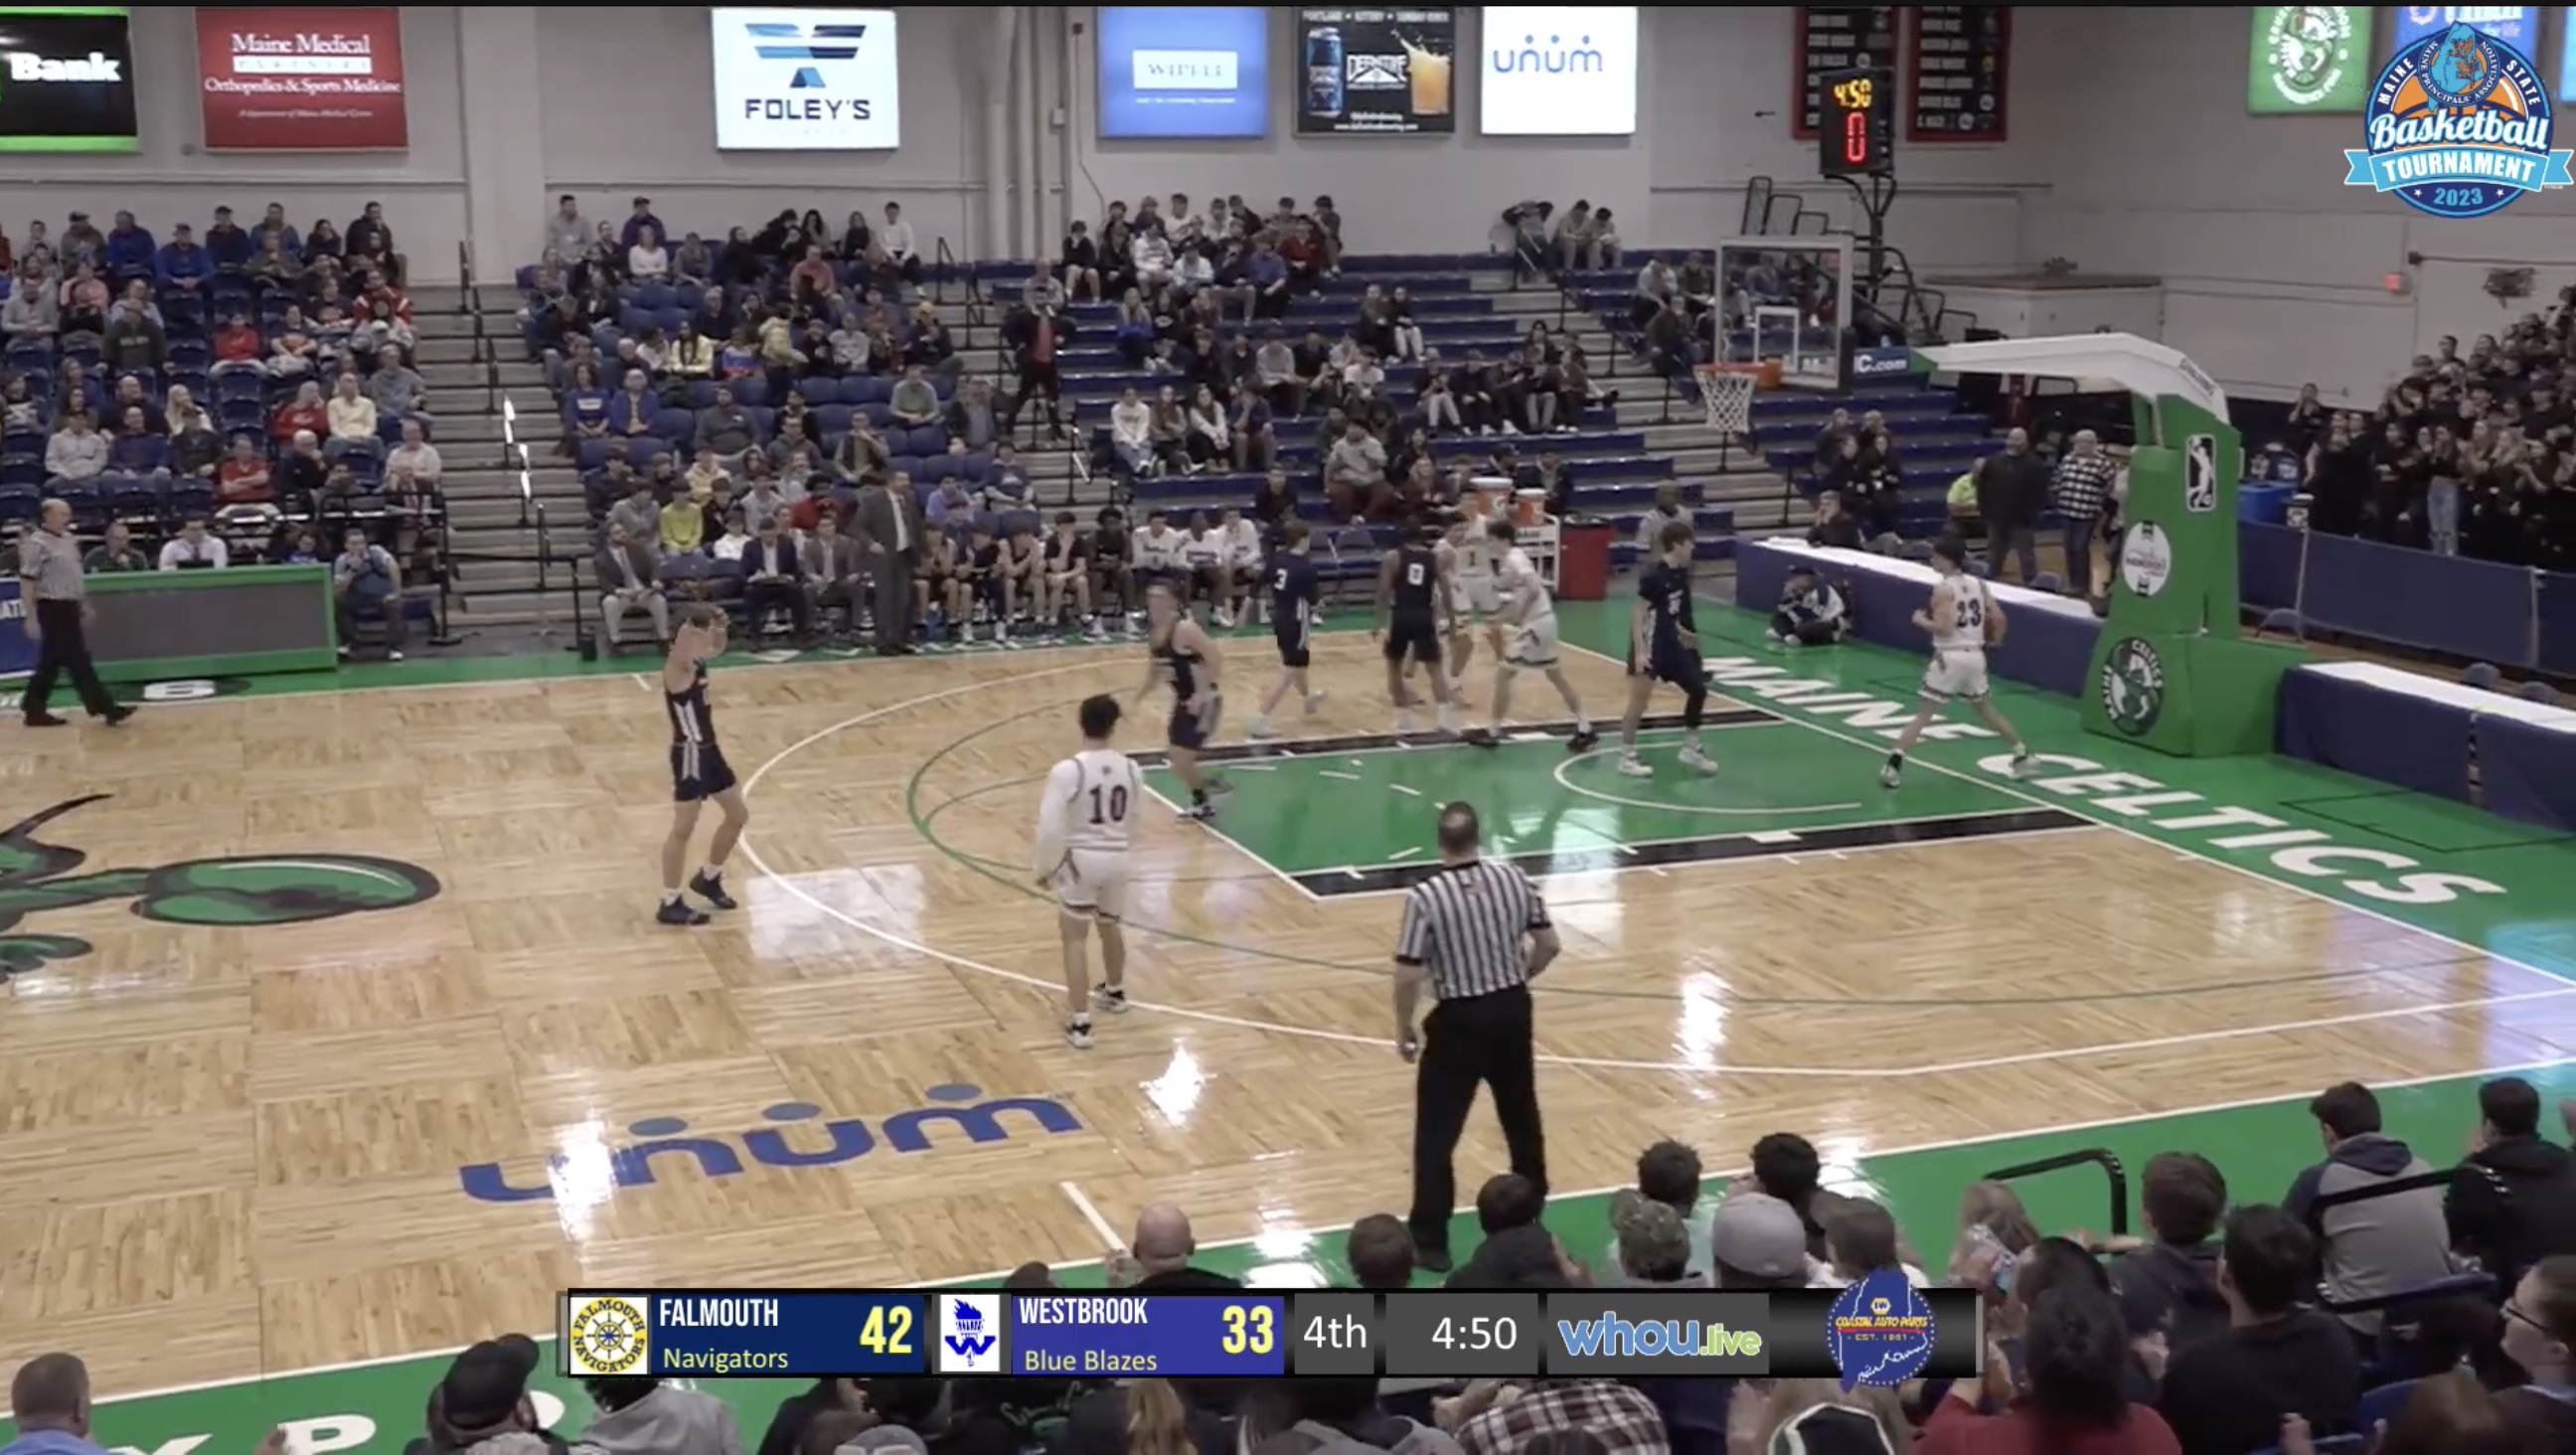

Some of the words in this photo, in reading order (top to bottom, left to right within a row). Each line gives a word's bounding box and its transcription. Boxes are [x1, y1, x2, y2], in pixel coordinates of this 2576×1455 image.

[232, 34, 292, 53] Maine
[296, 34, 371, 54] Medical
[1493, 35, 1603, 74] unum
[10, 51, 122, 81] Bank
[204, 78, 282, 96] Orthopedics
[300, 79, 341, 96] Sports
[343, 79, 402, 92] Medicine
[745, 98, 871, 120] FOLEY'S
[1275, 568, 1288, 590] 3
[1956, 597, 1982, 628] 23
[1702, 656, 2000, 742] MAINE
[1977, 753, 2507, 903] CELTICS
[1088, 784, 1128, 824] 10
